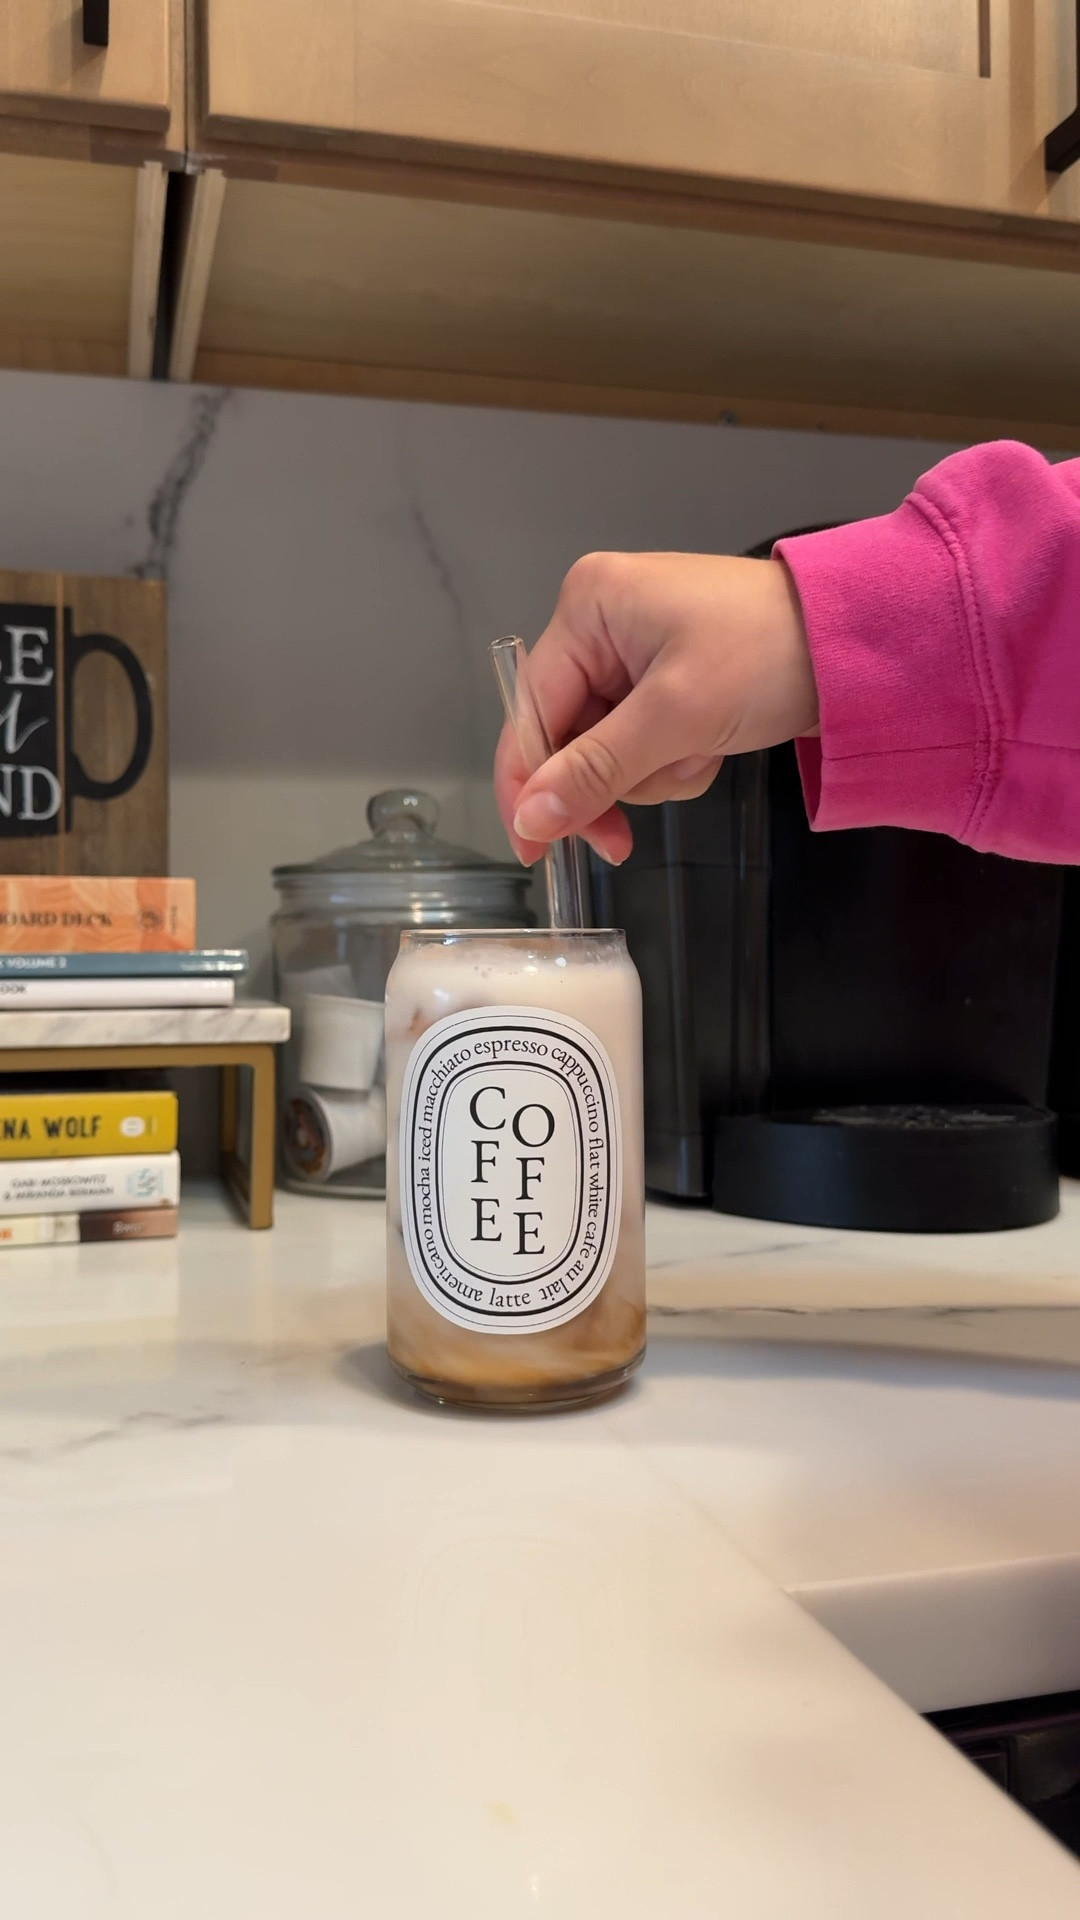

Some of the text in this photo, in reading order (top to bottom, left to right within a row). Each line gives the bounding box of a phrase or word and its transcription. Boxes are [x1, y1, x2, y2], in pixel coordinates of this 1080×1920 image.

[0, 625, 54, 686] E
[62, 911, 112, 928] DECK
[0, 1116, 31, 1140] NA
[43, 1114, 102, 1139] WOLF
[416, 1039, 604, 1308] espresso cappuccino flat white cafe au lait latte americano mocha iced macchiato
